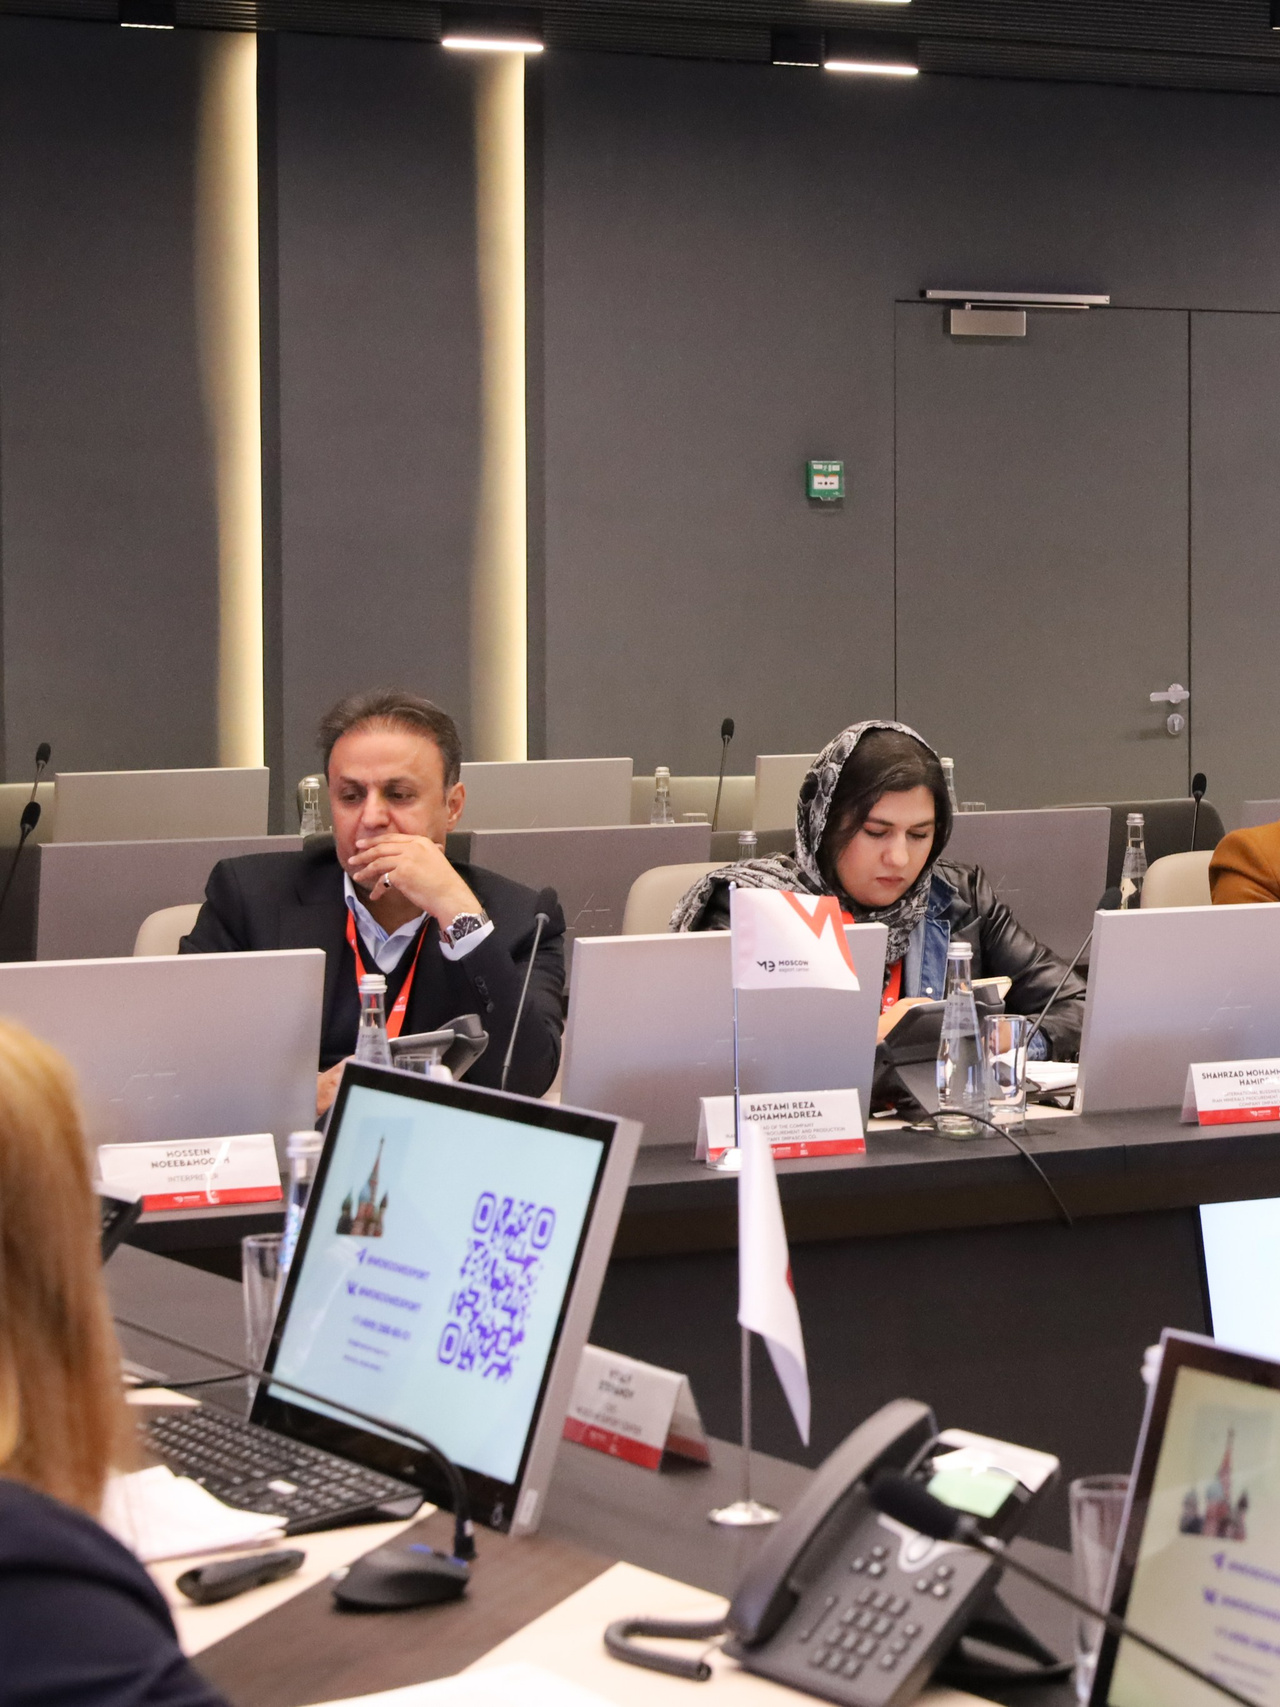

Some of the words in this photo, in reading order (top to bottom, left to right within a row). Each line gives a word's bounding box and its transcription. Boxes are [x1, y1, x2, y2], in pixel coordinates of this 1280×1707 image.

[1202, 1068, 1244, 1080] SHAHRZAD
[750, 1103, 789, 1112] BASTAMI
[792, 1101, 815, 1110] REZA
[745, 1110, 823, 1122] MOHAMMADREZA
[166, 1148, 210, 1158] HOSSEIN
[151, 1156, 230, 1169] NOEEBAHOOH
